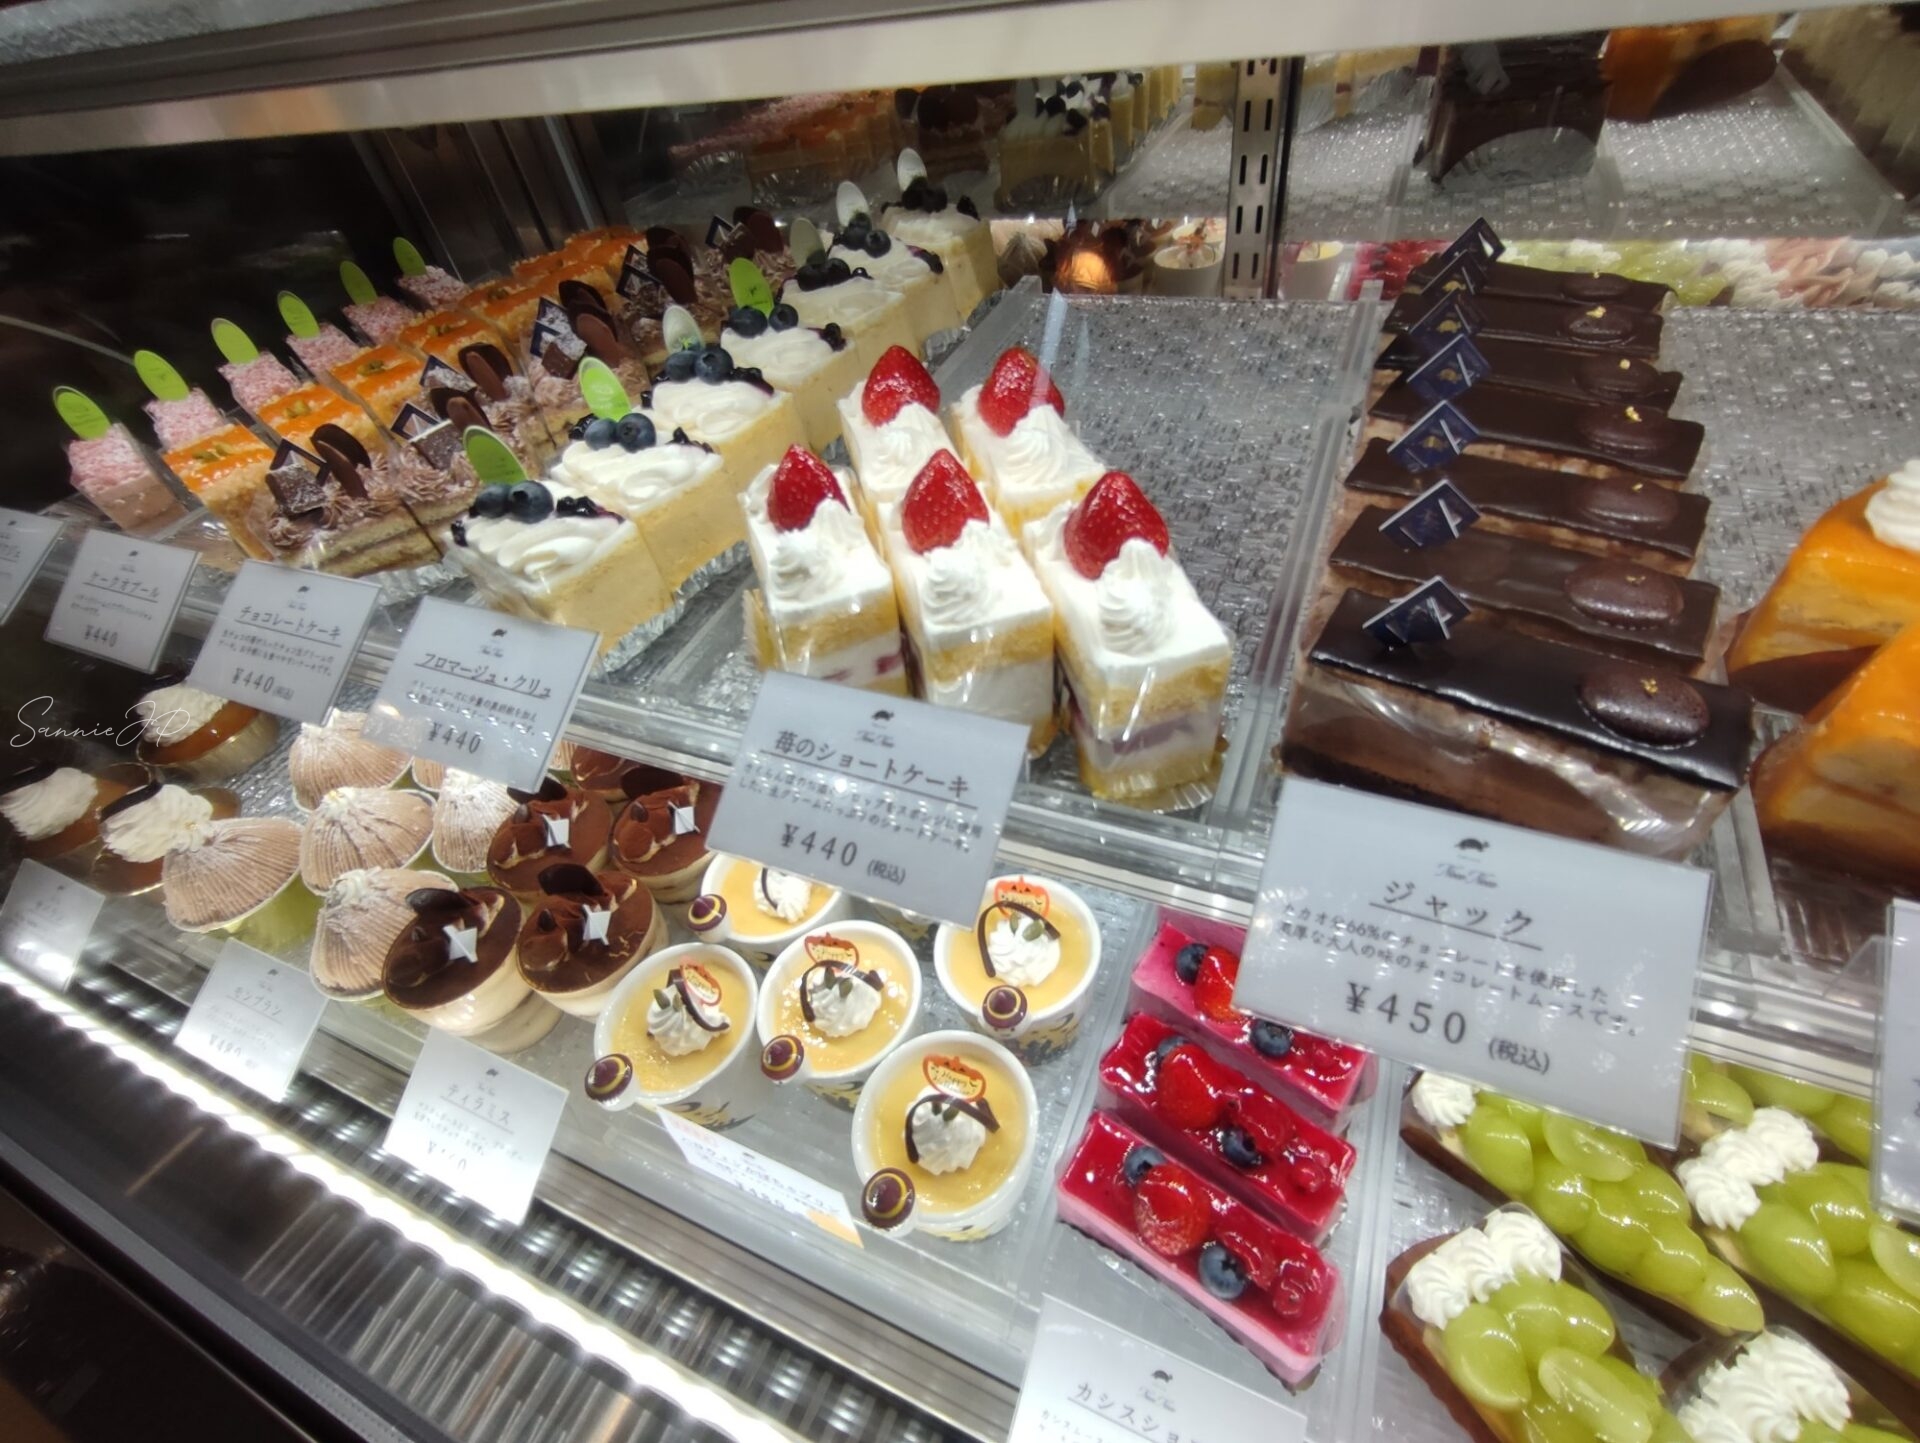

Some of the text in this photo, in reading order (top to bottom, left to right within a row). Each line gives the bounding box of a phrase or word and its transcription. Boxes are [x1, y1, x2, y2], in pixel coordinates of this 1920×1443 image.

[84, 624, 118, 648] ¥440
[239, 606, 341, 640] チョコレートケーキ
[232, 667, 275, 693] ¥440
[422, 653, 552, 699] フロマージュ・クリュ
[428, 722, 481, 754] ¥440
[775, 730, 969, 798] 苺のショートケーキ
[781, 823, 906, 885] ¥440 (税込)
[1382, 879, 1534, 938] ジャック
[1345, 982, 1550, 1075] ¥450 (税込)
[448, 1084, 511, 1126] ティラミス
[1077, 1382, 1199, 1443] カシスショ
